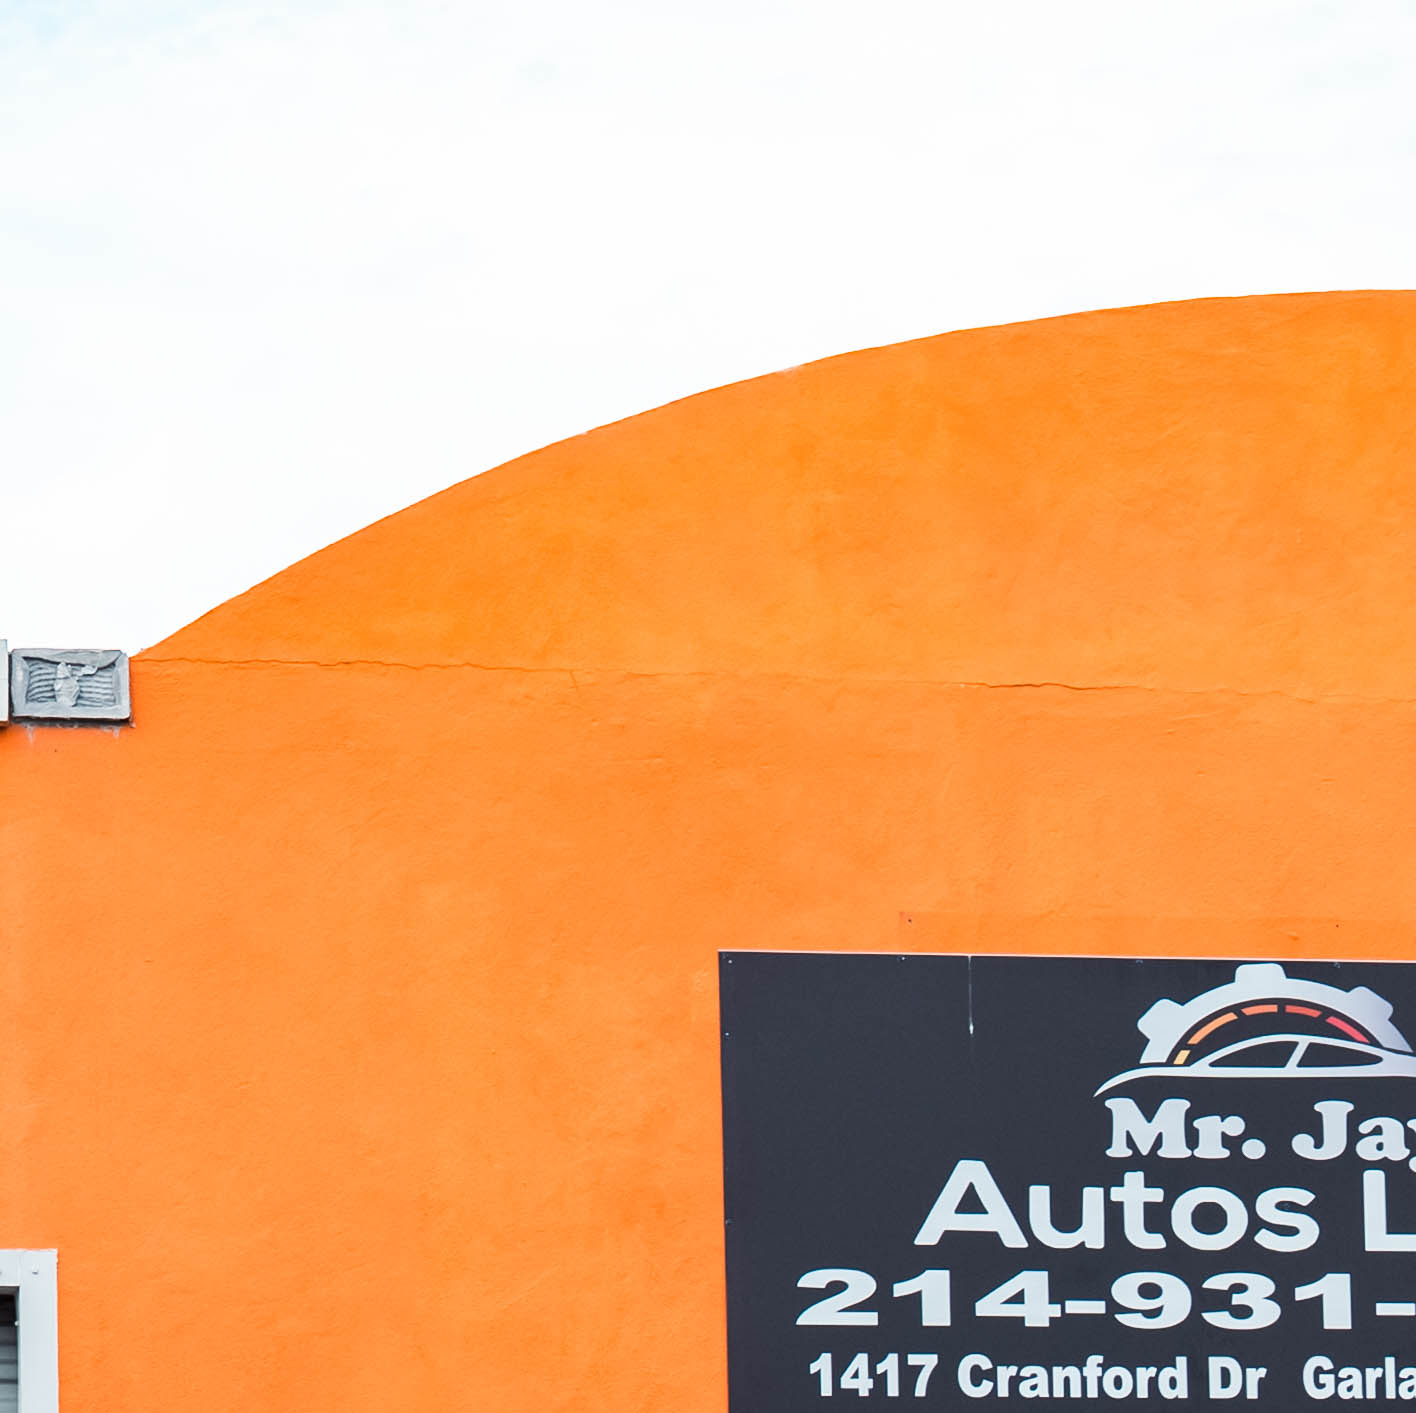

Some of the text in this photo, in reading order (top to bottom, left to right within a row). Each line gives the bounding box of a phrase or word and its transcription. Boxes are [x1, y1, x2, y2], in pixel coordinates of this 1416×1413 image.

[1105, 1098, 1265, 1159] Mr.
[914, 1159, 1320, 1252] Autos
[810, 1353, 938, 1397] 1417
[958, 1354, 1188, 1399] Cranford
[1208, 1357, 1267, 1399] Dr
